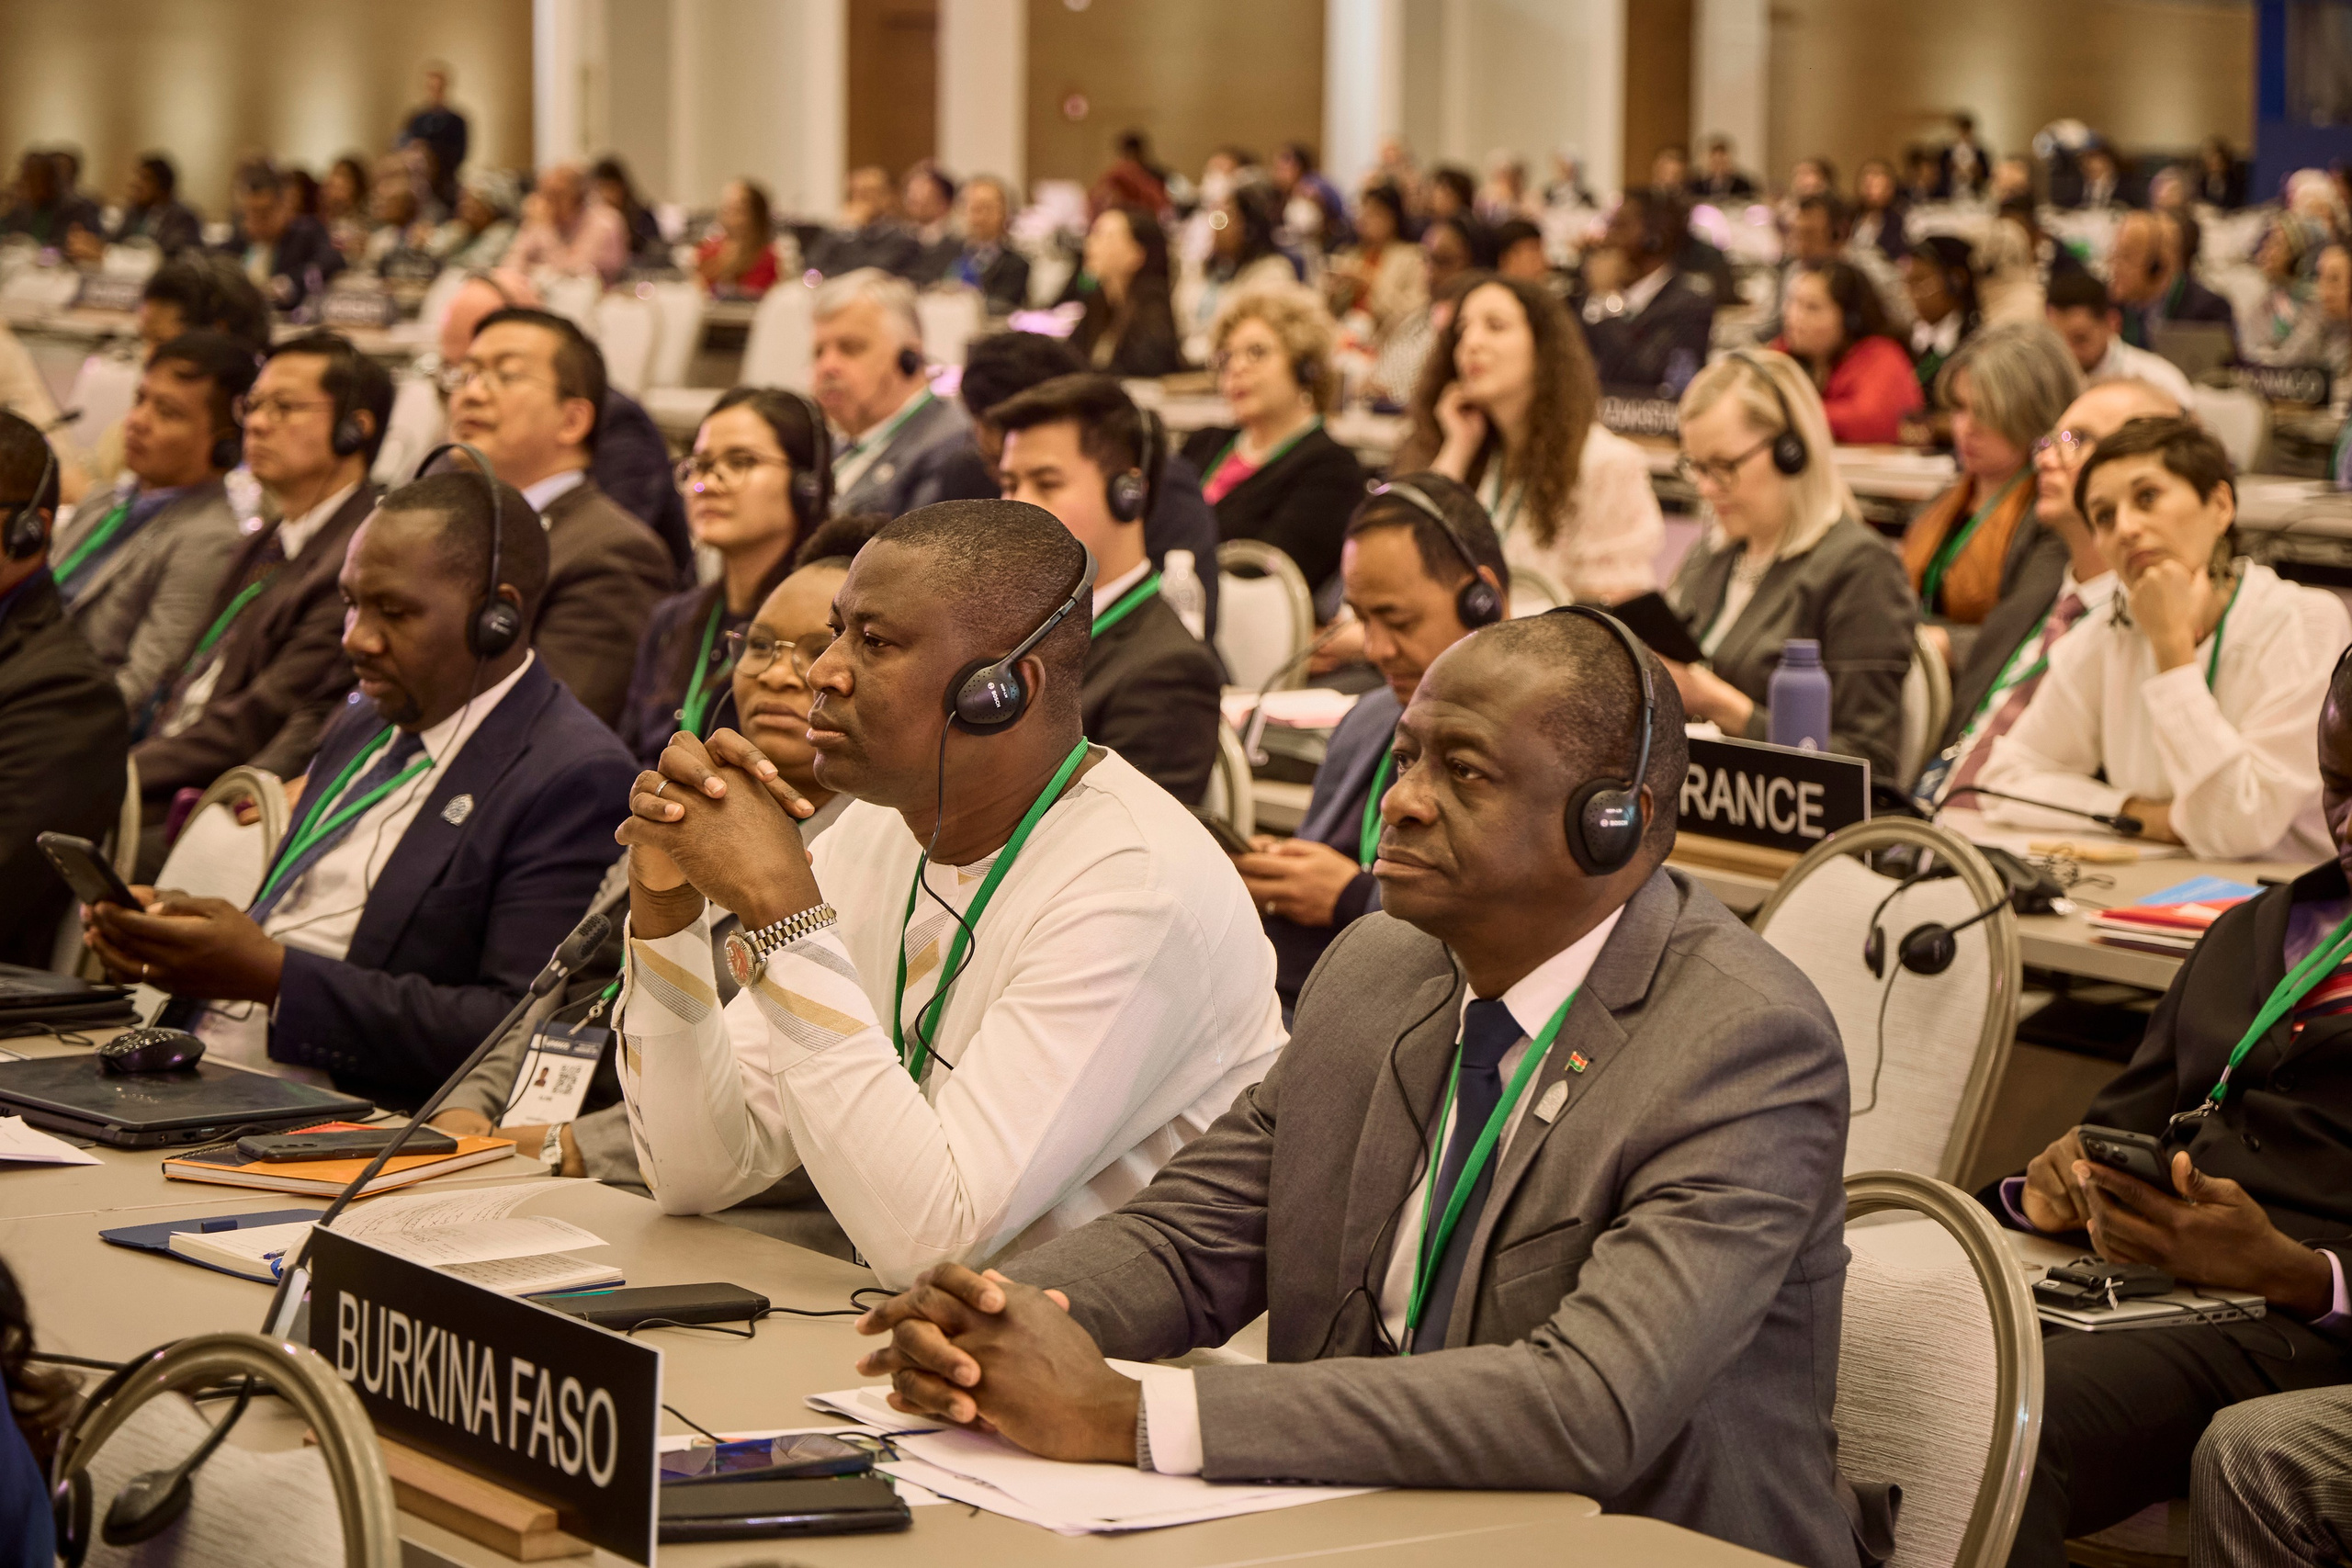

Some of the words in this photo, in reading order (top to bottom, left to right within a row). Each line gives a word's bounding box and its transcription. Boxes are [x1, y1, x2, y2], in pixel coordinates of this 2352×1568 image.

[991, 690, 1001, 707] BOSCH
[1679, 763, 1826, 839] RANCE
[337, 1290, 502, 1445] BURKINA
[509, 1356, 618, 1488] FASO
